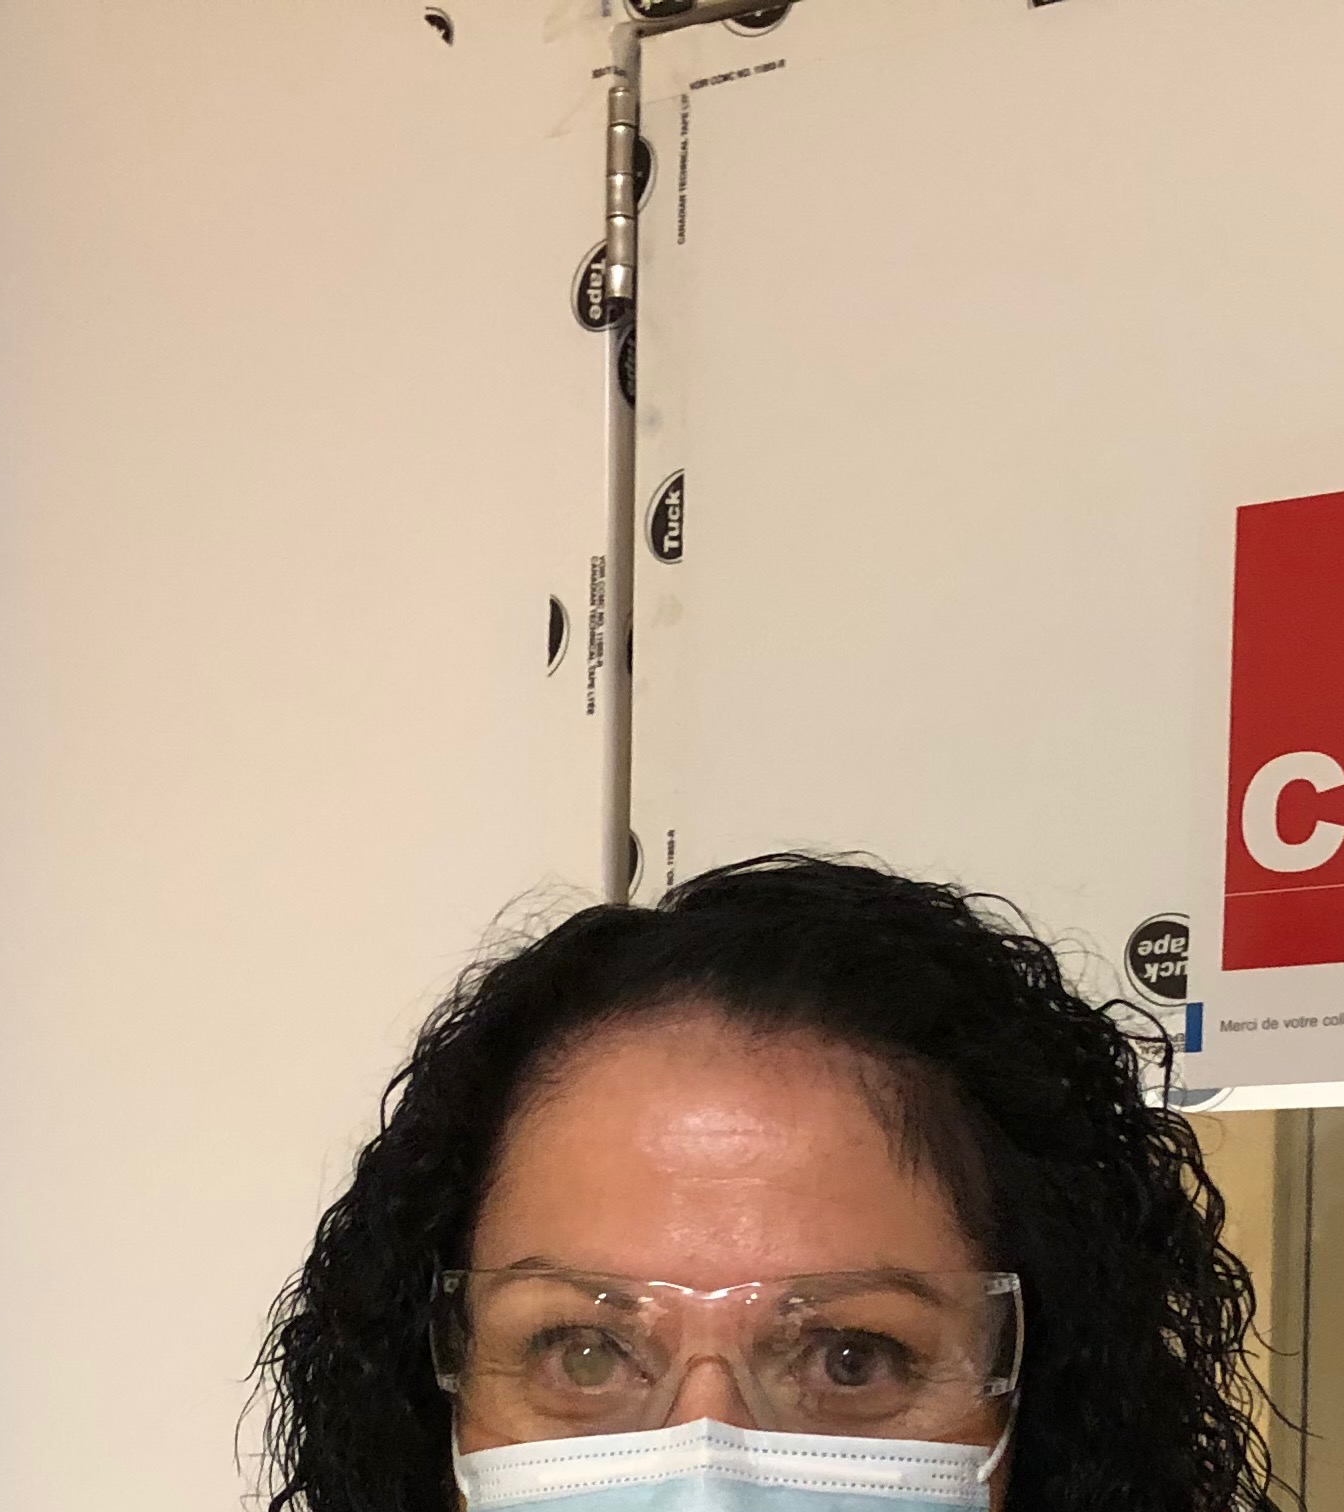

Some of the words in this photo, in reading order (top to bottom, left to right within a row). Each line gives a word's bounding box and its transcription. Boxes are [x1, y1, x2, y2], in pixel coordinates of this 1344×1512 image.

[587, 258, 606, 320] Tape
[663, 486, 682, 553] Tuck
[1138, 933, 1188, 960] ape
[1144, 959, 1188, 982] uck
[1219, 1019, 1258, 1033] Merci
[1261, 1017, 1280, 1030] de
[1283, 1015, 1319, 1029] votre
